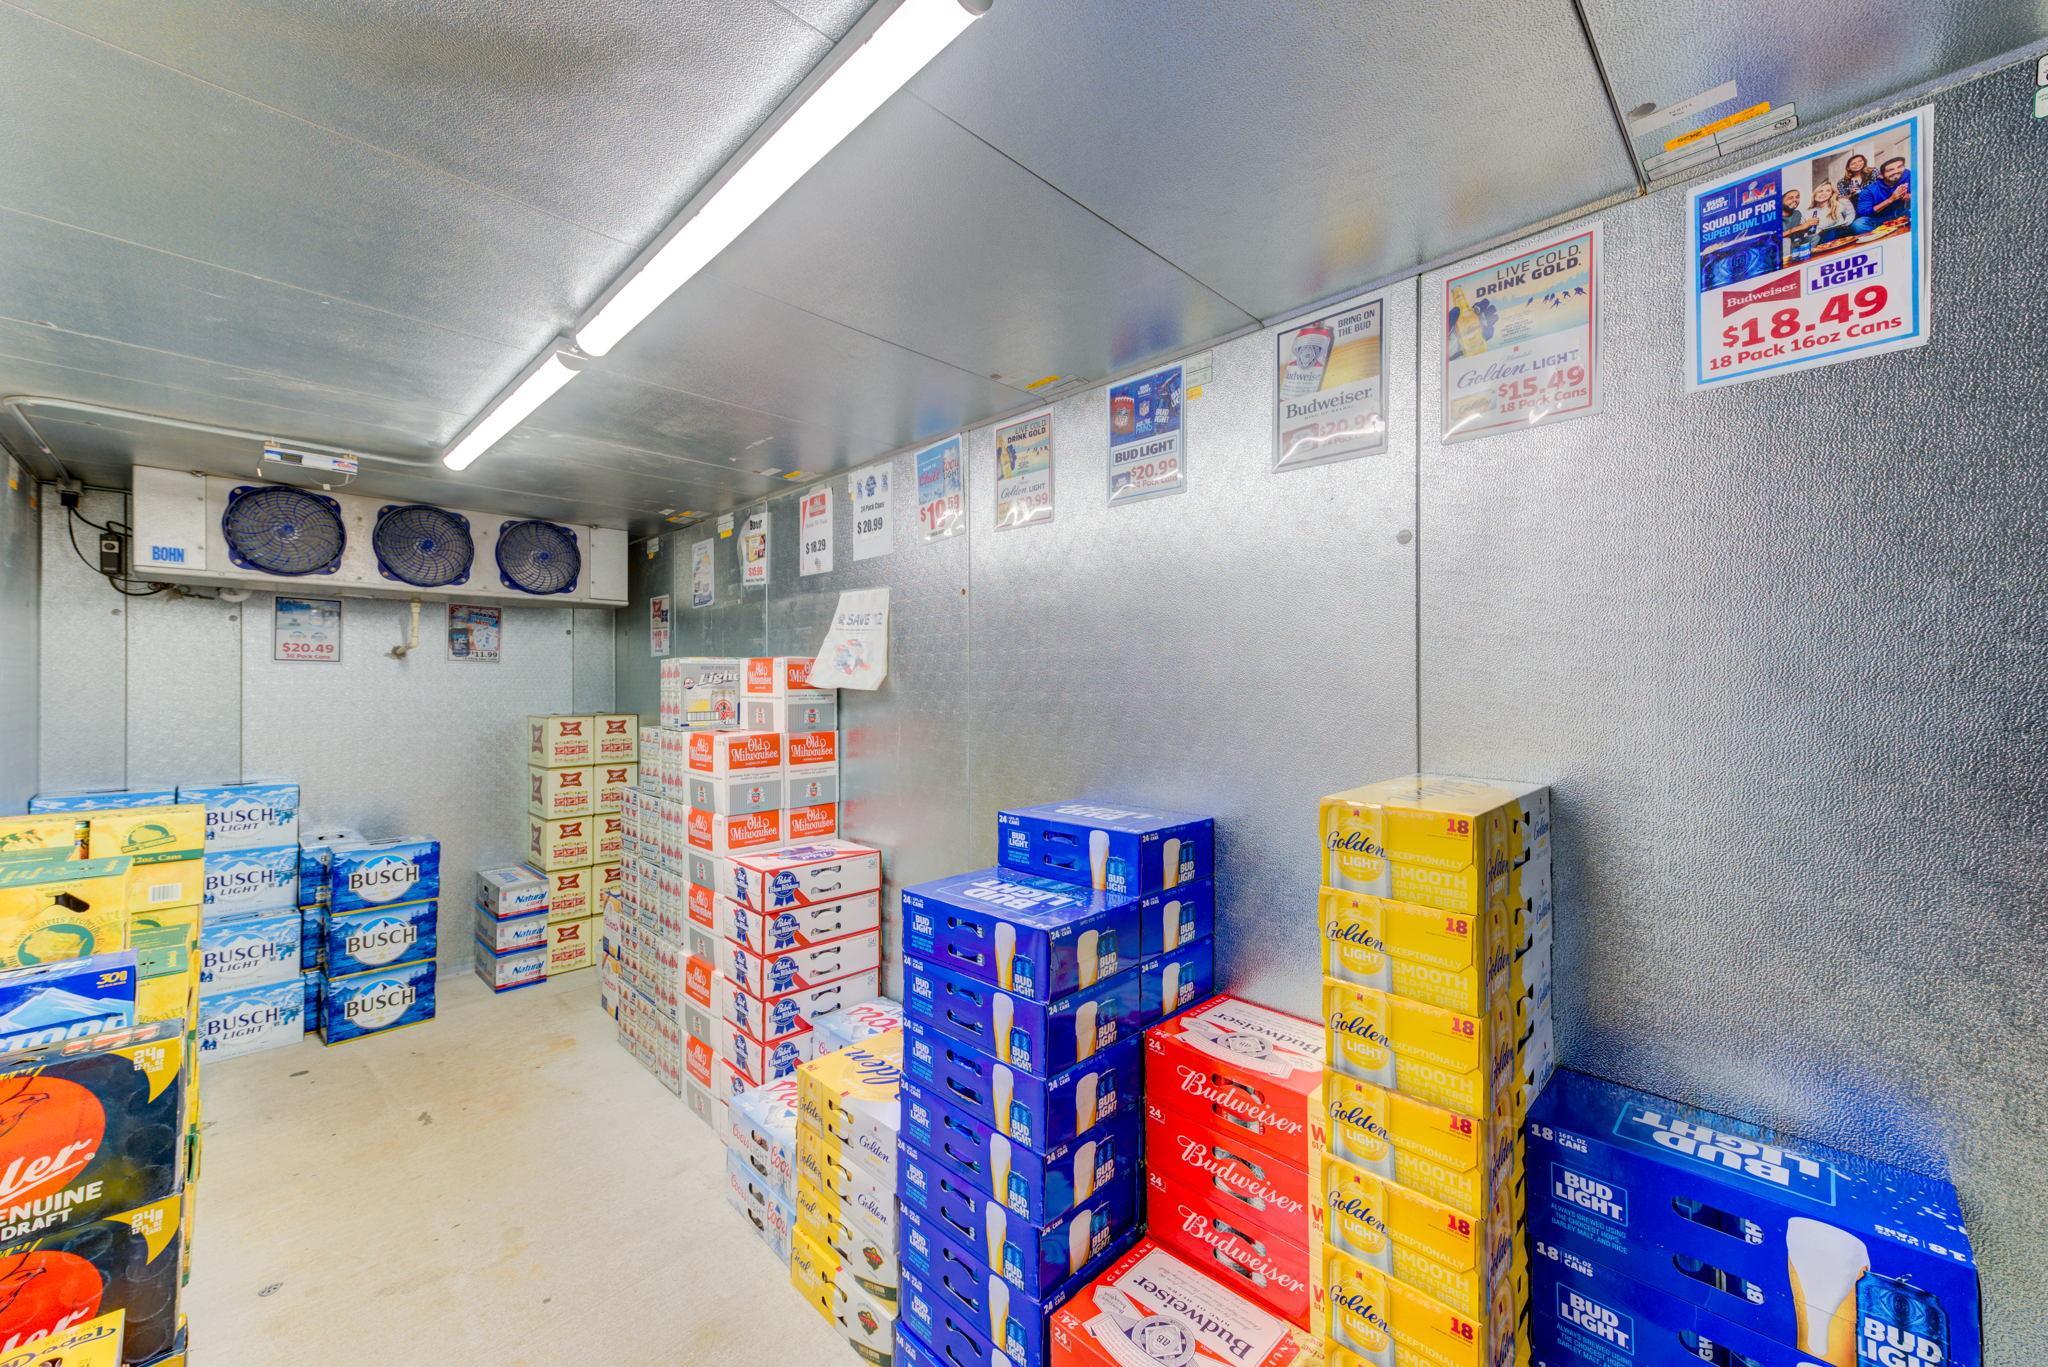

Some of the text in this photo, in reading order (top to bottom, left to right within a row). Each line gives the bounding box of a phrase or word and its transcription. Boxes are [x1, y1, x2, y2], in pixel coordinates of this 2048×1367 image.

[1702, 199, 1776, 233] SQUAD UP FOR
[1702, 211, 1777, 243] SUPER BOWL LVI
[1496, 260, 1531, 281] LIVE
[1820, 254, 1868, 276] BUD
[1475, 274, 1526, 299] DRINK
[1811, 262, 1879, 291] LIGHT
[1338, 309, 1376, 328] BRING ON
[1721, 284, 1890, 348] $18.49
[1338, 320, 1372, 338] THE BUD
[1709, 316, 1902, 371] 18 Pack 16oz Cans
[1457, 350, 1579, 391] Golden LIGHT
[1498, 365, 1586, 401] $15.49
[1285, 387, 1372, 420] Budweiser
[1554, 385, 1588, 402] Cans
[1007, 433, 1027, 445] DRINK
[1015, 425, 1029, 435] LIVE
[1115, 439, 1175, 464] BUD LIGHT
[1131, 458, 1178, 481] $20.99
[1001, 483, 1045, 499] Golden LIGHT
[863, 517, 883, 533] 20.99
[152, 546, 184, 562] BOHN
[282, 642, 334, 653] $20.49
[748, 737, 770, 751] Old
[791, 744, 833, 758] Milwaukee
[806, 735, 827, 748] Old
[731, 749, 778, 762] Milwaukee
[206, 808, 273, 826] BUSCH
[747, 816, 769, 829] Old
[806, 808, 828, 821] Old
[220, 823, 259, 832] LIGHT
[730, 827, 777, 841] Milwaukee
[792, 818, 834, 832] Milwaukee
[1447, 819, 1469, 834] 18
[1008, 838, 1028, 849] LIGHT
[1011, 831, 1026, 841] BUD
[1327, 830, 1387, 858] Golden
[1343, 855, 1379, 870] LIGHT
[206, 871, 273, 890] BUSCH
[350, 866, 418, 890] BUSCH
[1106, 882, 1127, 893] LIGHT
[1108, 874, 1125, 885] BUD
[1394, 866, 1467, 889] SMOOTH
[220, 885, 258, 896] LIGHT
[515, 892, 547, 904] Natural
[963, 888, 1040, 910] BUD
[912, 922, 933, 936] LIGHT
[915, 915, 930, 926] BUD
[1445, 918, 1468, 934] 18
[348, 928, 416, 953] BUSCH
[513, 926, 545, 939] Natural
[1326, 920, 1385, 952] Golden
[204, 943, 274, 967] BUSCH
[1344, 947, 1378, 963] LIGHT
[219, 960, 259, 973] LIGHT
[512, 961, 544, 975] Natural
[1393, 961, 1468, 989] SMOOTH
[346, 988, 414, 1019] BUSCH
[207, 1007, 278, 1035] BUSCH
[1331, 1012, 1390, 1048] Golden
[1452, 1017, 1475, 1036] 18
[223, 1025, 264, 1040] LIGHT
[1213, 1013, 1322, 1054] Budweiser
[1149, 1038, 1161, 1050] 24
[1346, 1040, 1383, 1060] LIGHT
[1177, 1065, 1303, 1136] Budweiser
[1149, 1106, 1162, 1118] 24
[1330, 1101, 1389, 1141] Golden
[1450, 1115, 1472, 1135] 18
[1531, 1123, 1554, 1141] 18
[859, 1135, 889, 1163] Golden
[1558, 1139, 1588, 1154] CANS
[1632, 1111, 1820, 1178] LIGHT
[1653, 1130, 1790, 1186] BUD
[1149, 1173, 1162, 1186] 24
[1177, 1135, 1304, 1216] Budweiser
[1564, 1171, 1613, 1201] BUD
[0, 1180, 104, 1228] ENUINE
[858, 1194, 887, 1224] Golden
[1329, 1190, 1387, 1236] Golden
[1, 1208, 73, 1241] DRAFT
[1551, 1203, 1627, 1238] ALWAYS BREWED USING
[1556, 1212, 1567, 1222] THE
[1568, 1216, 1600, 1235] CHOICEST
[1551, 1218, 1575, 1233] BARLEY
[1597, 1235, 1611, 1248] AND
[1612, 1242, 1628, 1254] RICE
[1177, 1204, 1305, 1294] Budweiser
[1537, 1241, 1559, 1261] 18
[1928, 1243, 1966, 1262] 18
[1107, 1242, 1153, 1282] GENUINE
[1564, 1259, 1593, 1277] CANS
[1133, 1276, 1254, 1361] Budweiser
[1330, 1285, 1390, 1333] Golden
[1570, 1293, 1619, 1327] BUD
[1054, 1327, 1068, 1345] 24
[1864, 1317, 1943, 1364] BUD
